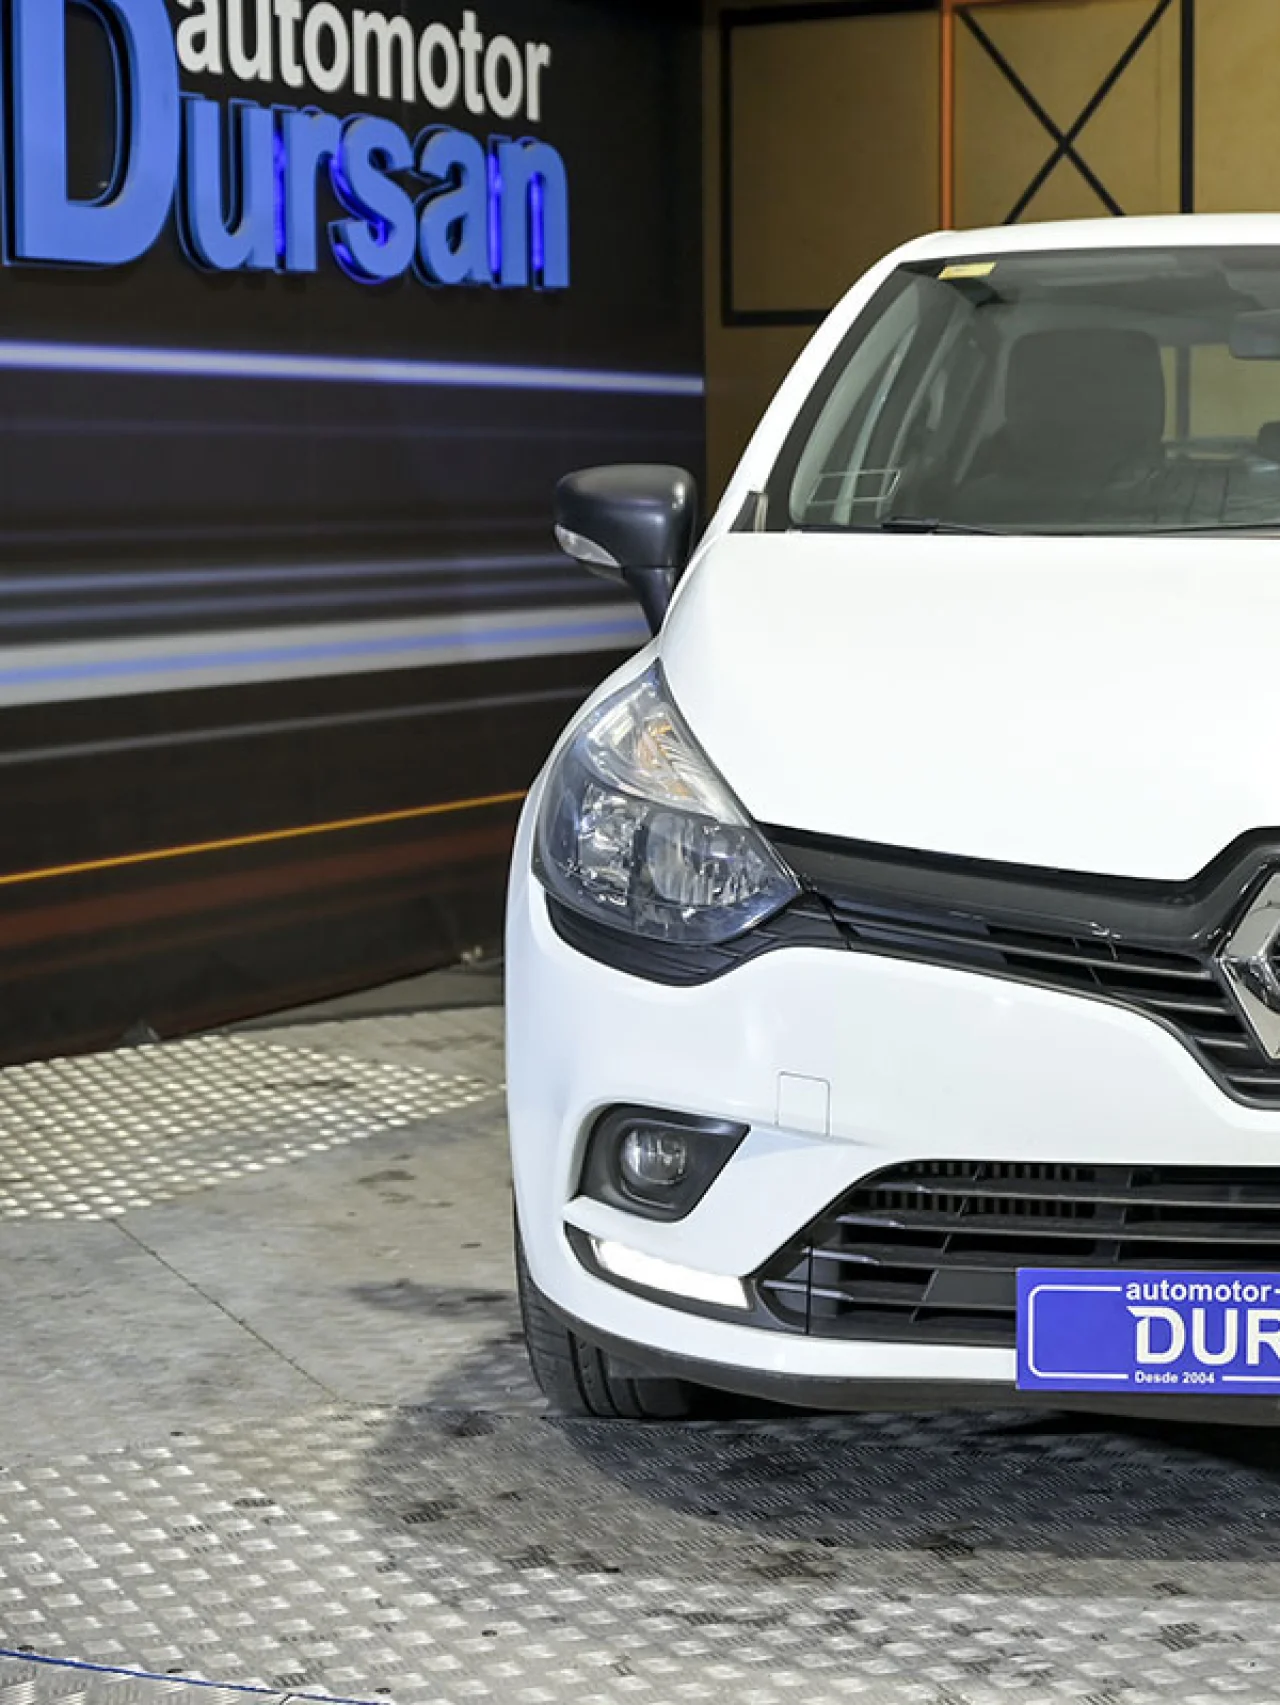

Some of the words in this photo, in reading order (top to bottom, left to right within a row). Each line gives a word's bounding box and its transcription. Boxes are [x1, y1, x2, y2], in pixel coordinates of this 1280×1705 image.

[177, 0, 550, 121] automotor
[2, 0, 571, 290] Dursan
[1125, 1279, 1272, 1303] automotor
[1134, 1370, 1178, 1384] Desde
[1182, 1371, 1215, 1384] 2004
